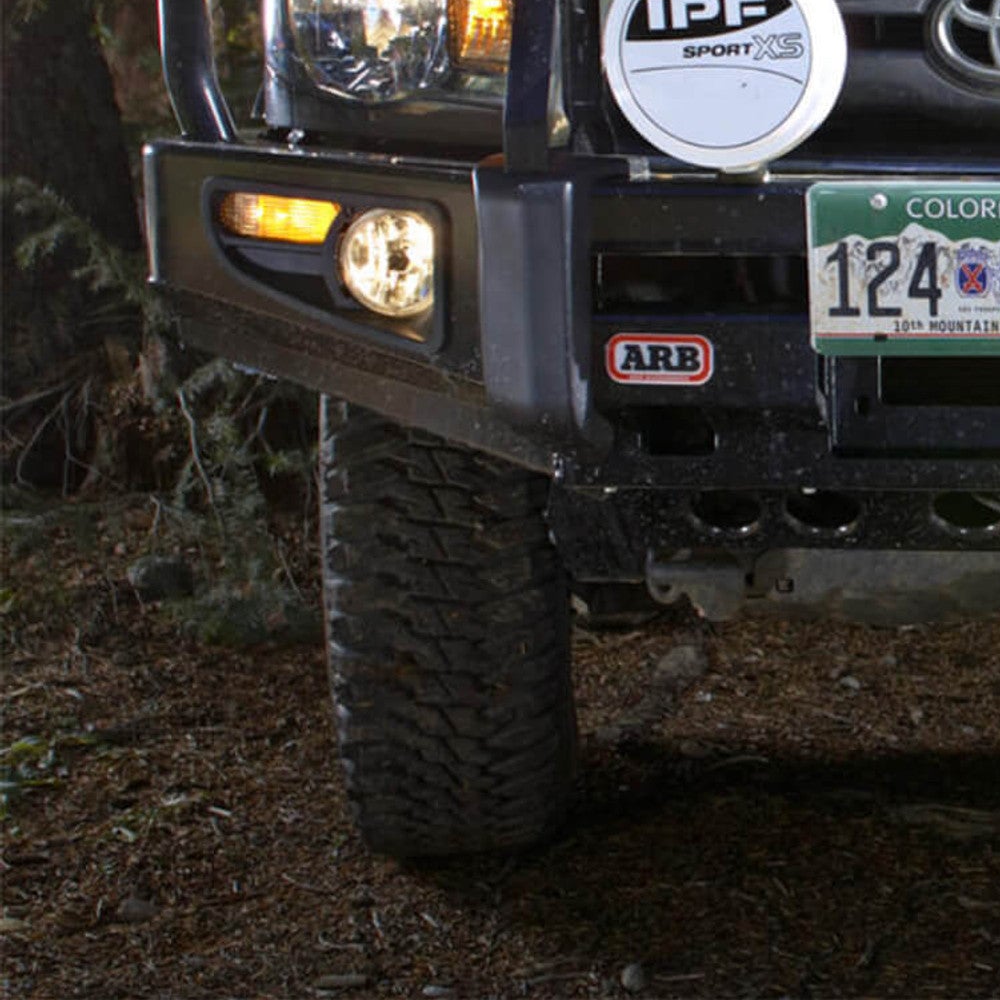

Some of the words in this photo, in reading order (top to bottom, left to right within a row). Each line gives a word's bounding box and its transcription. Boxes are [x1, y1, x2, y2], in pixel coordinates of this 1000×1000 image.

[826, 241, 942, 318] 124
[929, 319, 999, 333] MOUNTAIN
[620, 344, 700, 372] ARB
